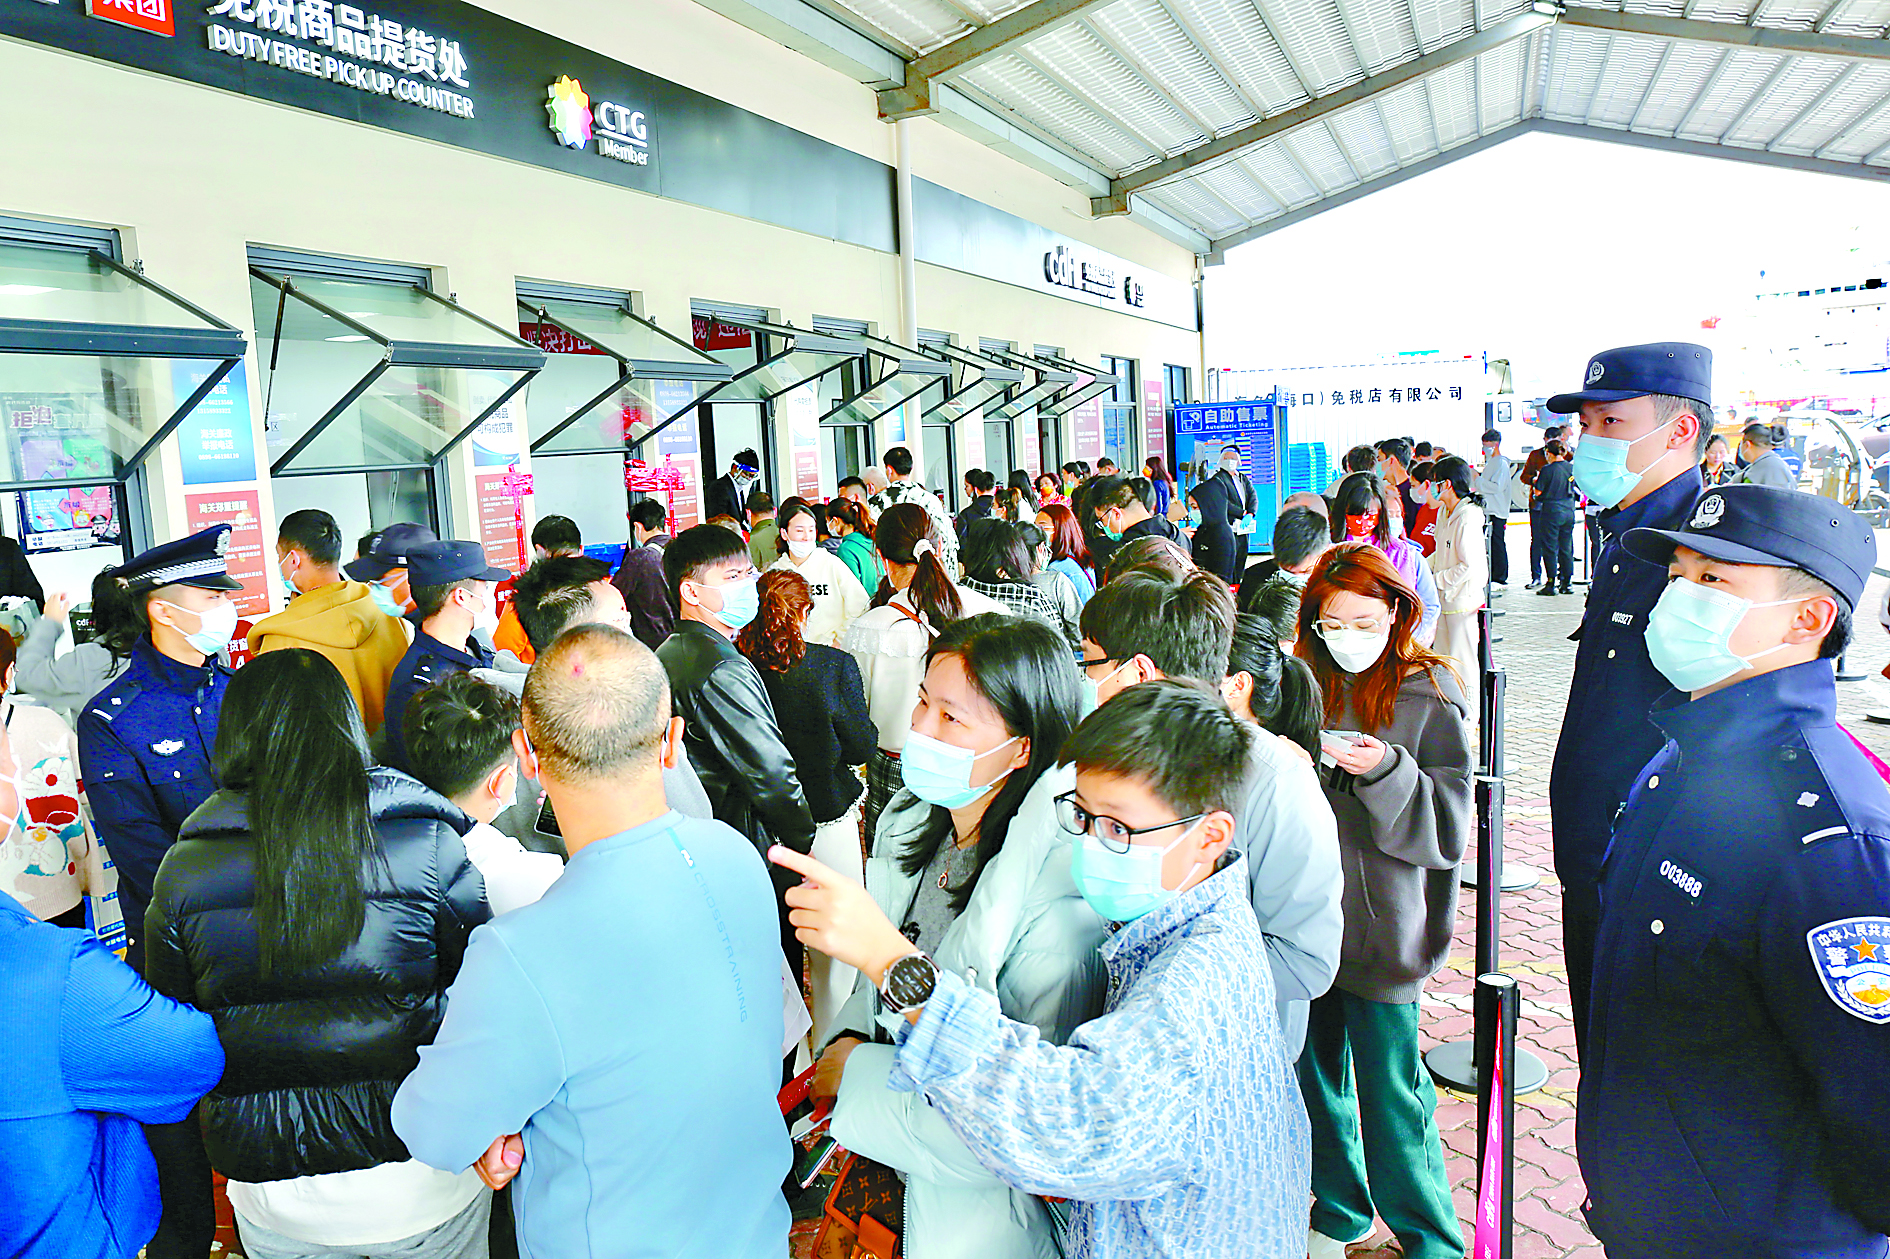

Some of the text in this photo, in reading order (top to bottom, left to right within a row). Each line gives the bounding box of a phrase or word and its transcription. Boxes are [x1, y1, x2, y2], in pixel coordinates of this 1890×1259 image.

[210, 24, 474, 118] DUTY FREE PICK UP COUNTER
[598, 101, 647, 140] CTG
[602, 138, 648, 165] Member
[1205, 406, 1268, 424] 自助售票
[1660, 860, 1703, 898] 003888
[694, 872, 748, 1023] CROSSTRAINING
